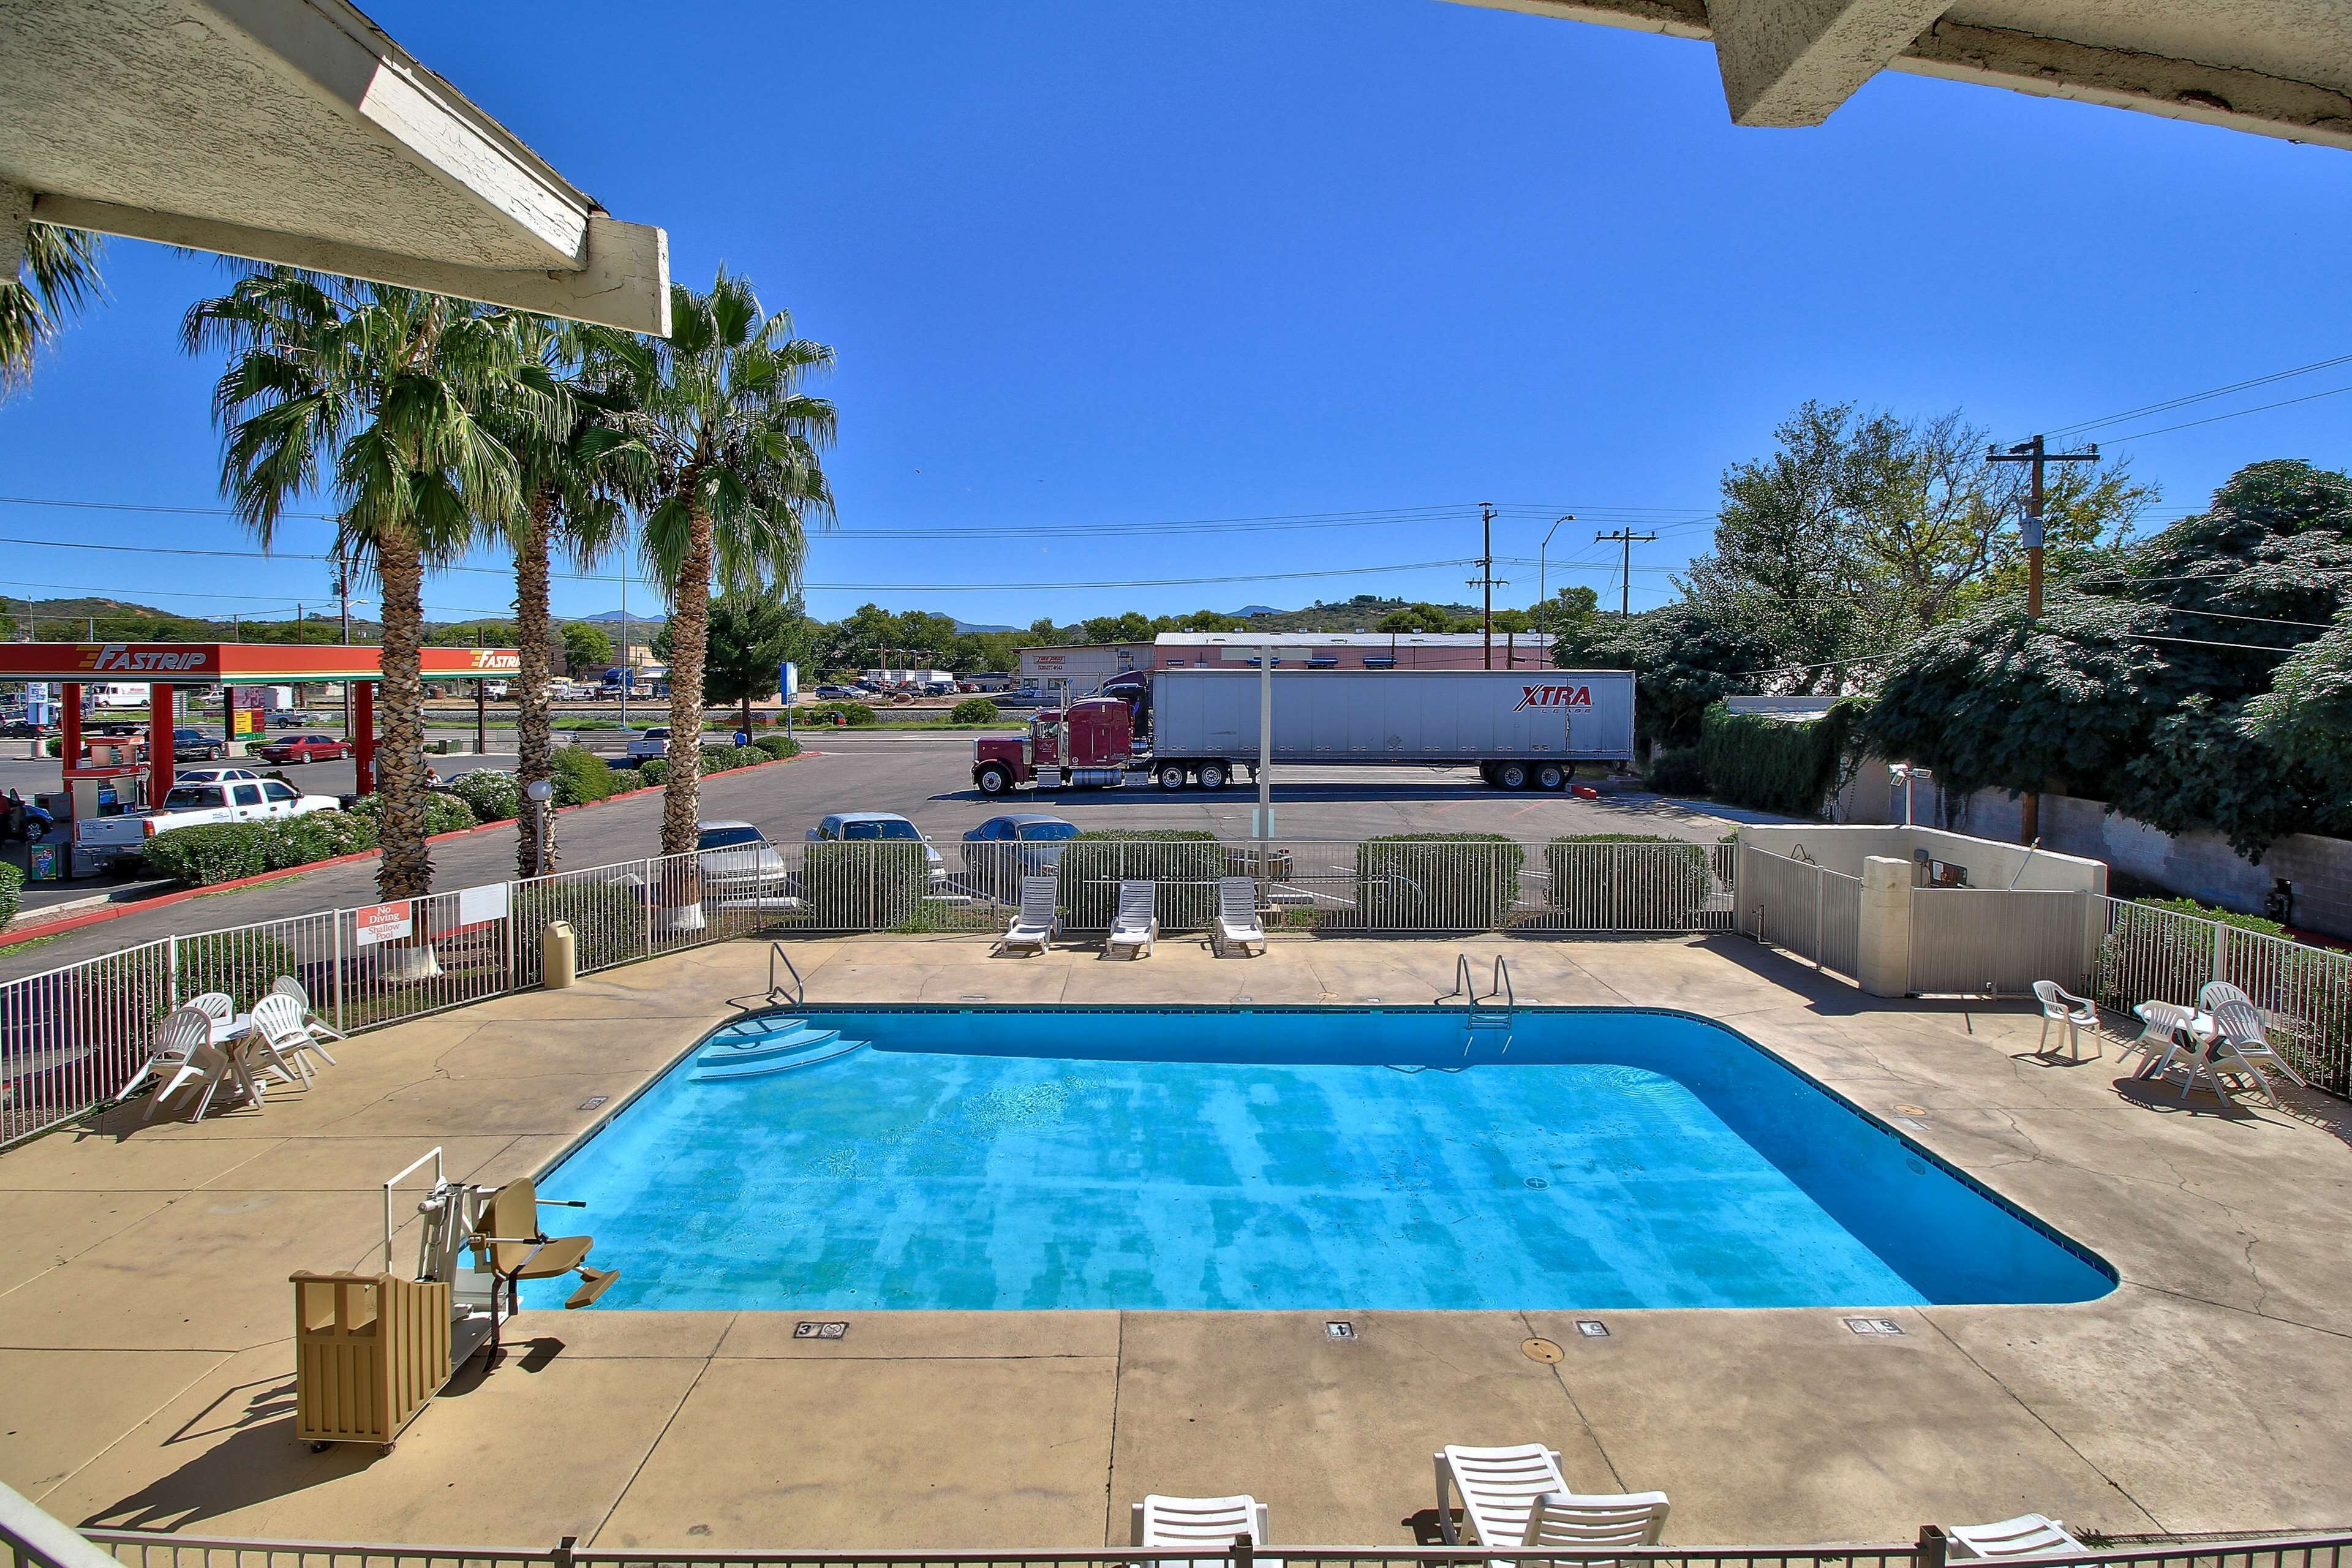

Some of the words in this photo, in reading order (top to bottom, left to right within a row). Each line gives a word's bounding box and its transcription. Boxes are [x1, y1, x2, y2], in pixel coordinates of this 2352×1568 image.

[94, 645, 206, 669] FASTRIP
[478, 650, 521, 668] FASTRI
[1513, 684, 1591, 712] XTRA
[377, 905, 391, 914] No
[369, 912, 400, 924] Diving
[368, 923, 400, 935] Shallow
[376, 932, 393, 940] Pool
[799, 1325, 812, 1335] 3
